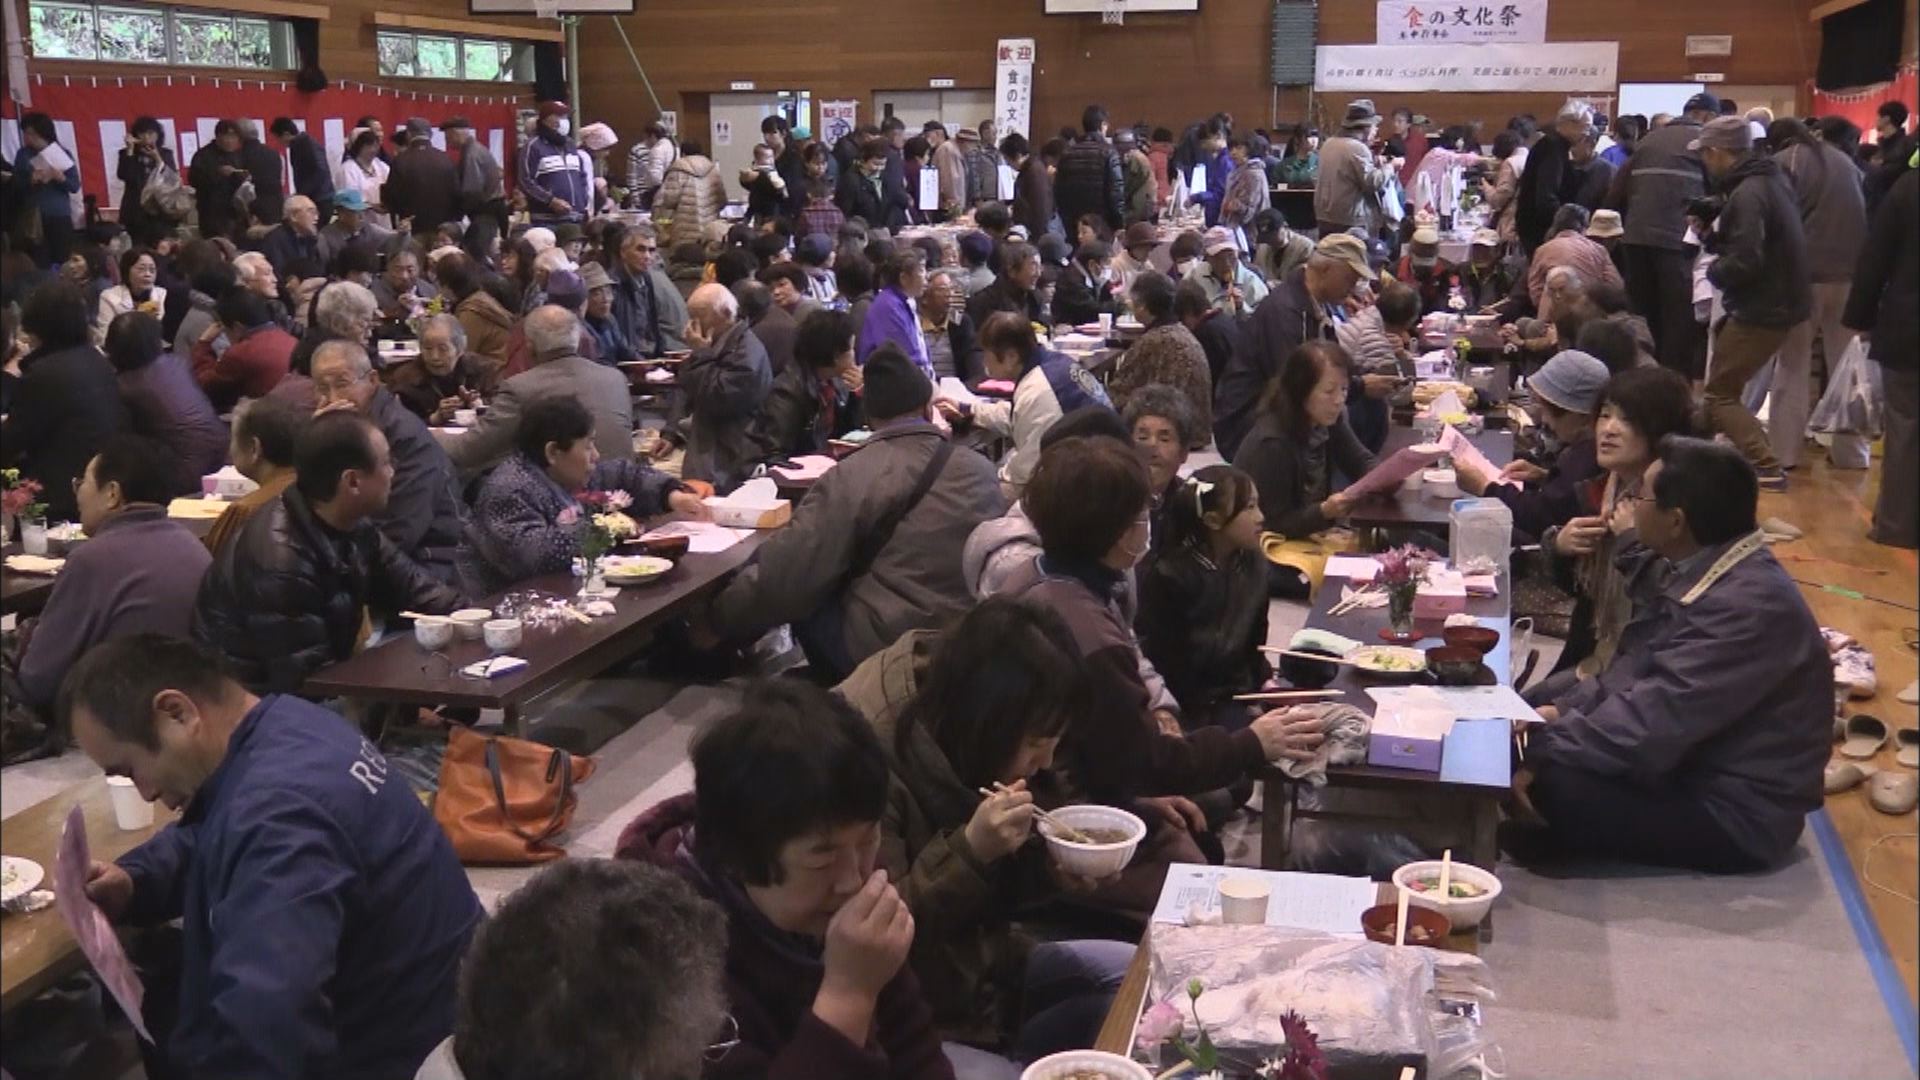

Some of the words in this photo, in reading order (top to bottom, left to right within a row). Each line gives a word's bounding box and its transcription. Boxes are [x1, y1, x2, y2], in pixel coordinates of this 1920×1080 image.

[1403, 4, 1523, 29] 食の文化祭
[998, 44, 1032, 61] 歓迎
